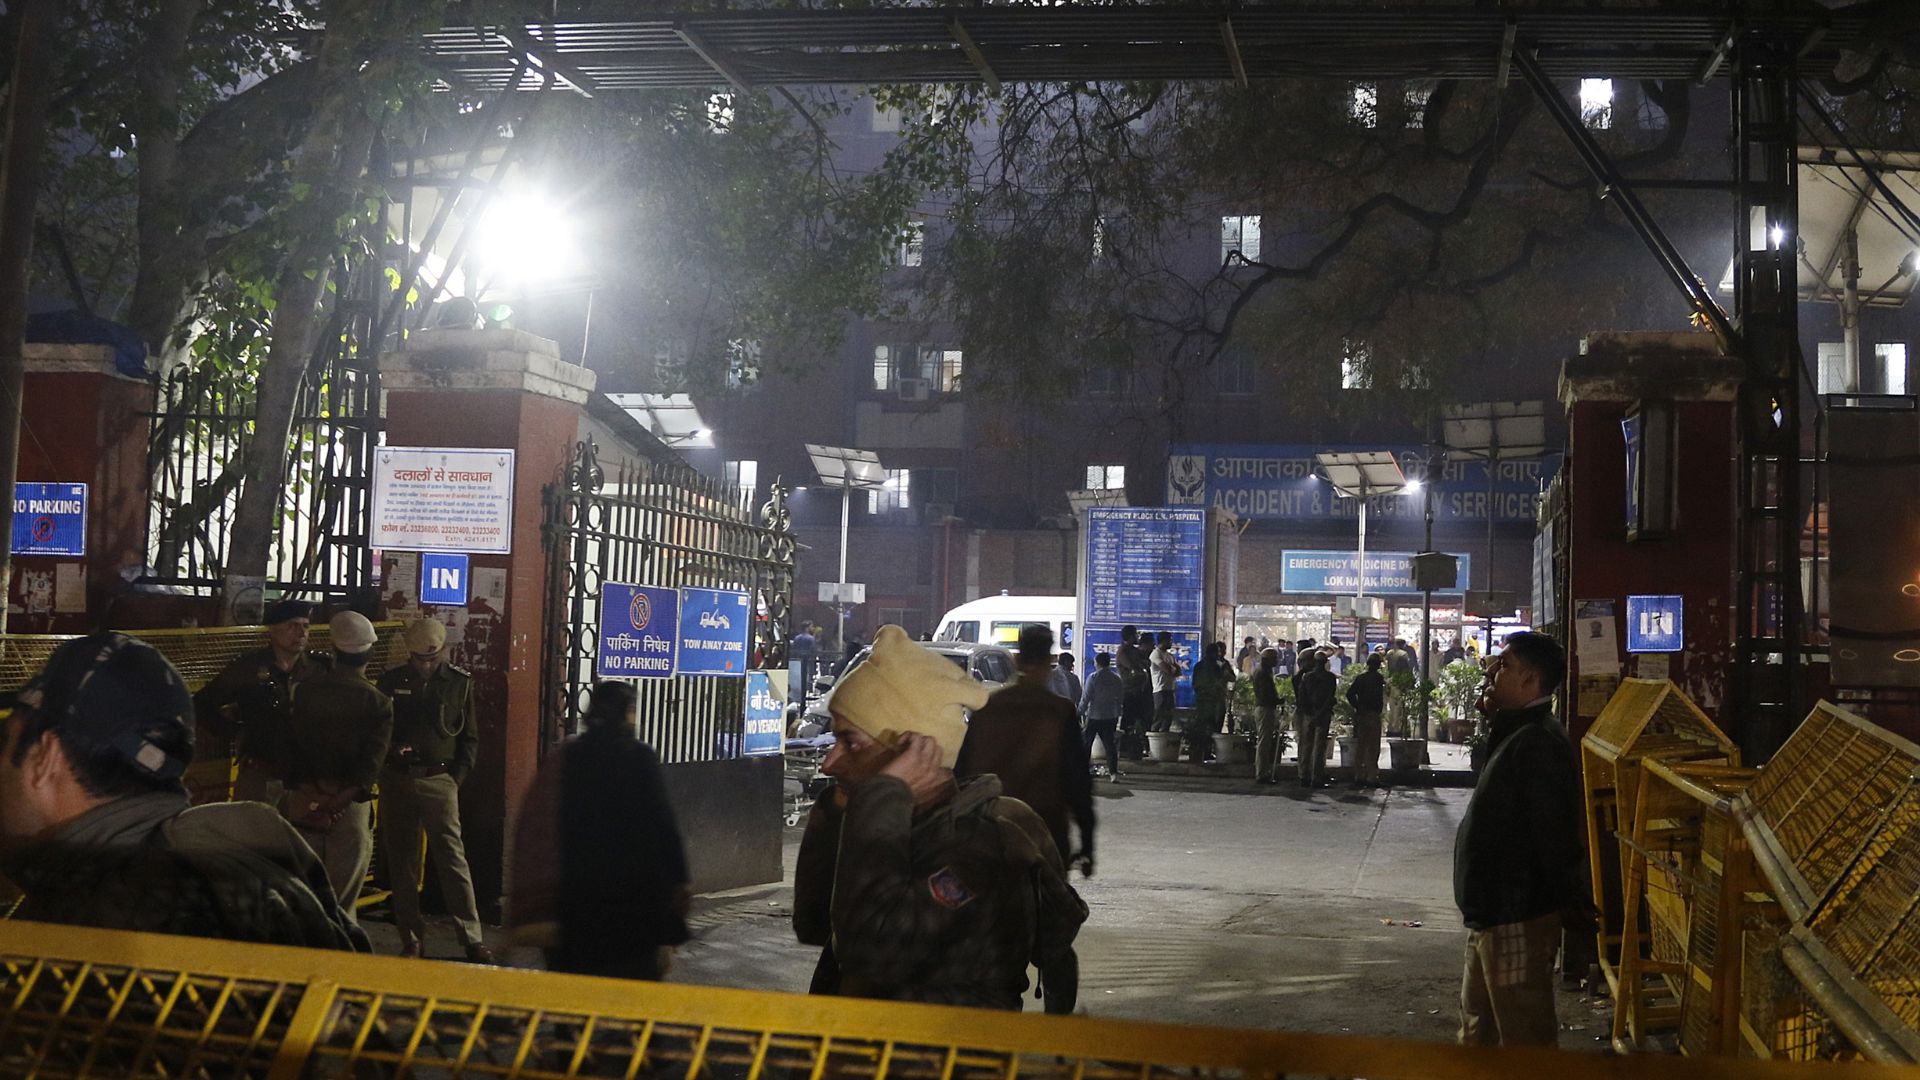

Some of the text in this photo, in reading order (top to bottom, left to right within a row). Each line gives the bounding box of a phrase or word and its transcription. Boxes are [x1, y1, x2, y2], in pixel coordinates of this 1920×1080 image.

[394, 467, 492, 483] दलालों से सावधान
[30, 500, 81, 514] PARKING
[1213, 488, 1304, 515] ACCIDENT
[1311, 491, 1323, 513] &
[1289, 558, 1348, 570] EMERGENCY
[1350, 559, 1396, 570] MDICINE
[431, 567, 459, 589] IN
[1324, 576, 1344, 587] LOK
[1640, 612, 1673, 635] IN
[606, 632, 671, 653] पार्किंग निषेध
[684, 640, 743, 651] TOW AWAY ZONE
[605, 656, 670, 671] NO PARKING
[747, 720, 757, 735] NO
